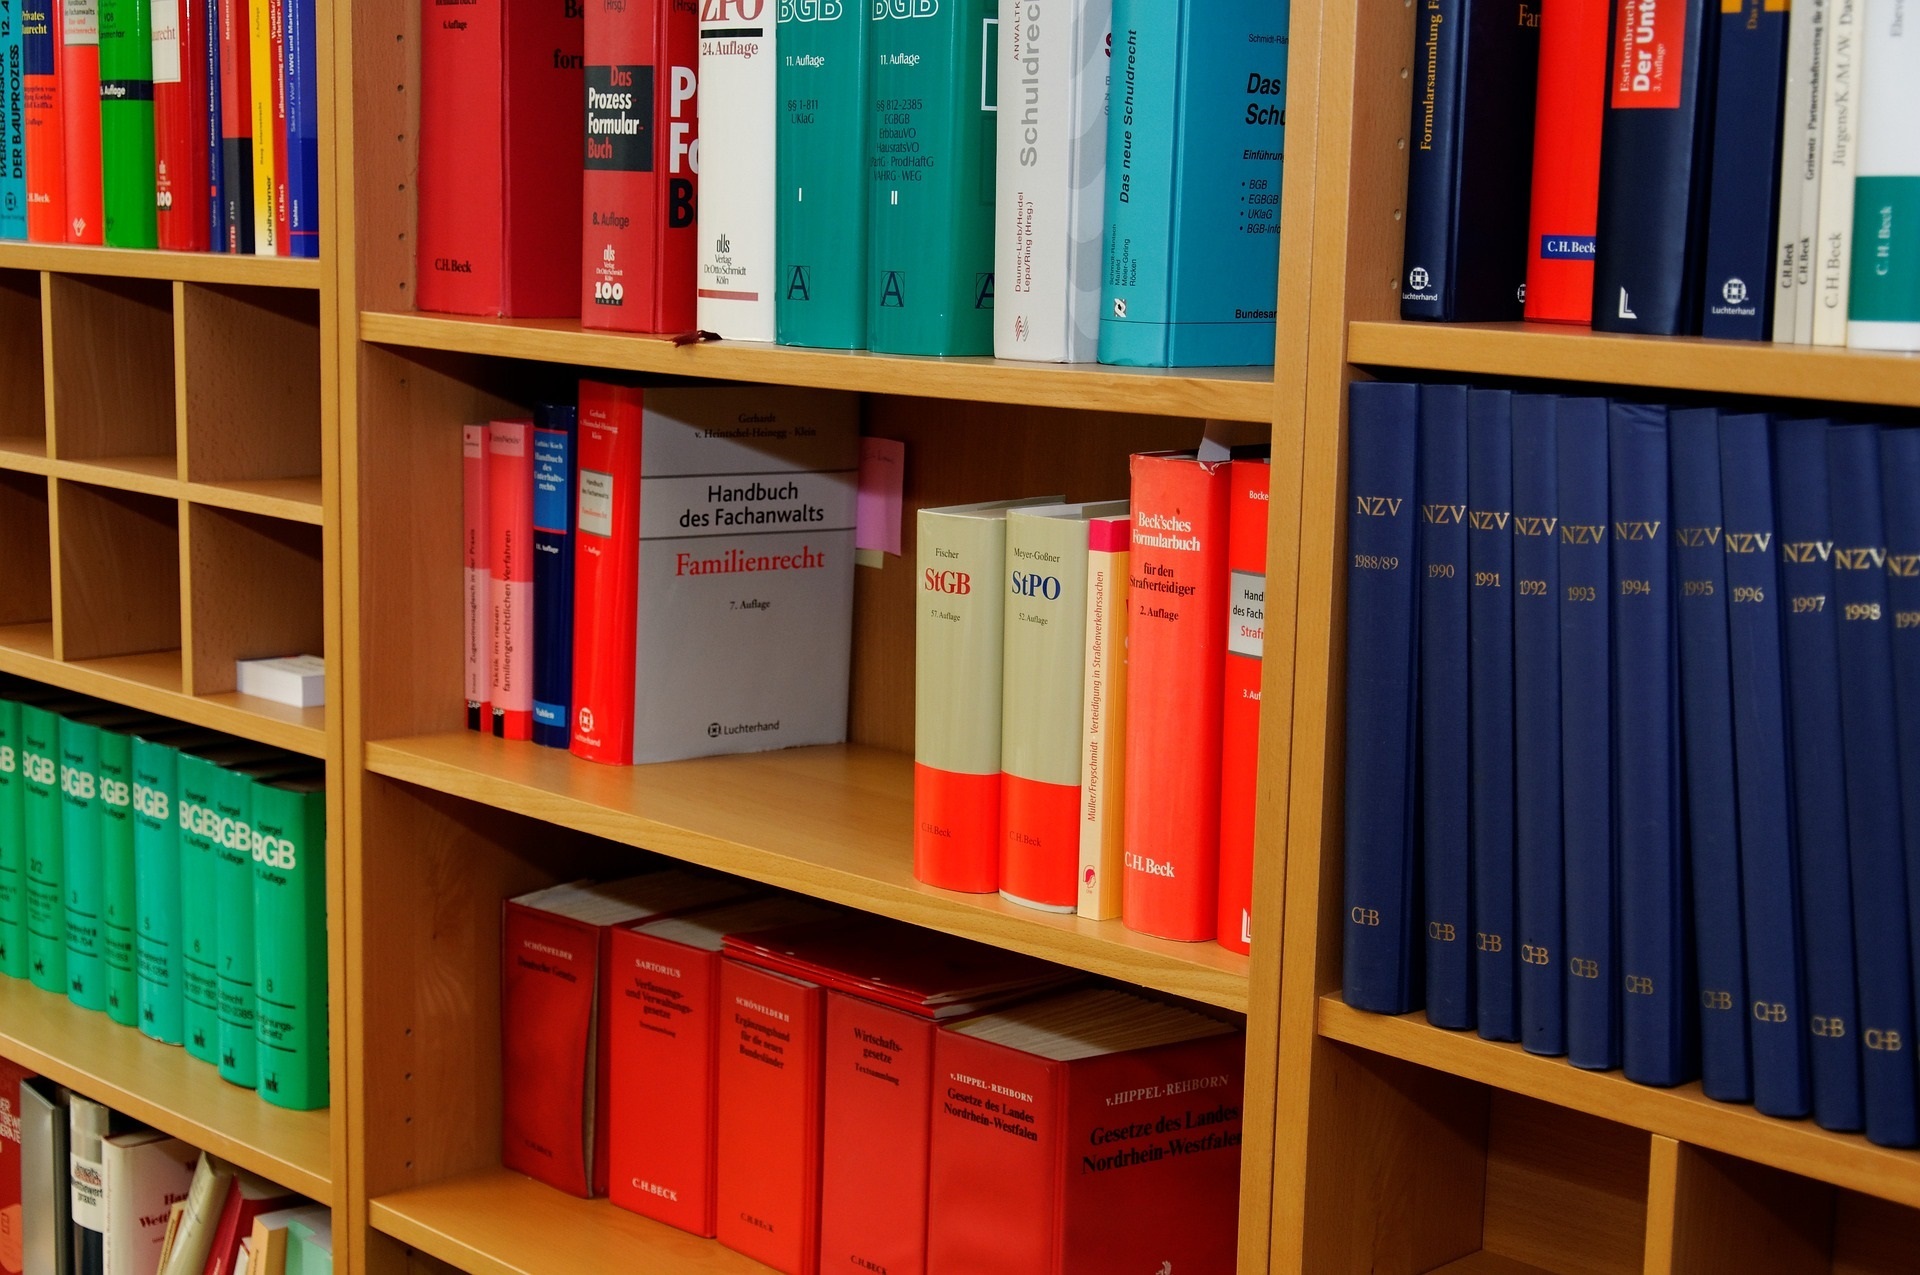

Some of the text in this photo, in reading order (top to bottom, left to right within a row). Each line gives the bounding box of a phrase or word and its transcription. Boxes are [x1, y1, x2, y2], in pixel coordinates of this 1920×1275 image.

[777, 0, 842, 23] BGB
[872, 0, 938, 21] BGB
[2, 20, 10, 37] 12.
[716, 41, 759, 59] Auflage
[1619, 0, 1636, 92] Eschenbruch
[795, 55, 825, 68] Auflage
[889, 53, 920, 67] Auflage
[1653, 43, 1667, 80] Auflage
[610, 66, 632, 87] Das
[1632, 50, 1652, 91] Der
[1246, 72, 1281, 96] Das
[1420, 14, 1443, 151] Formularsammlung
[10, 45, 23, 179] DER BAUPROZESS
[799, 100, 819, 109] 1-811
[886, 99, 923, 110] 812-2385
[884, 113, 910, 124] EGBGB
[1119, 29, 1137, 204] Das neue Schuldrecht
[879, 127, 917, 138] ErbbauVO
[587, 137, 613, 159] Buch
[876, 141, 920, 153] HausratsVO
[1799, 237, 1811, 285] C.H.Beck
[1808, 27, 1823, 130] Partnerschaftsvertrag
[890, 156, 934, 167] ProdHaftG
[901, 170, 922, 181] WEG
[1249, 179, 1268, 190] BGB
[1248, 194, 1279, 205] EGBGB
[602, 212, 630, 229] Auflage
[1247, 208, 1273, 219] UKlaG
[1015, 191, 1024, 292] Dauner-Lieb/Heidel
[1024, 202, 1034, 293] Lepa/Ring (Hrsg.)
[1547, 240, 1596, 254] C.H.Beck
[434, 258, 472, 273] C.H.Beck
[714, 254, 732, 266] Verlag
[1121, 238, 1131, 287] Meier-Göring
[1781, 243, 1794, 289] C.H.Beck
[722, 265, 746, 276] Schmidt
[1825, 232, 1843, 309] C.H.Beck
[716, 276, 729, 285] Köln
[595, 281, 624, 300] 100
[1402, 292, 1438, 302] Luchterhand
[1711, 306, 1756, 316] Luchterhand
[542, 463, 552, 472] des
[708, 481, 798, 503] Handbuch
[1356, 496, 1402, 516] NZV
[1422, 504, 1466, 524] NZV
[679, 504, 824, 528] des Fachanwalts
[1138, 511, 1192, 533] Beck'sches
[1469, 511, 1509, 530] NZV
[1514, 517, 1557, 536] NZV
[1561, 525, 1605, 544] NZV
[1615, 521, 1661, 541] NZV
[1132, 528, 1200, 552] Formularbuch
[1676, 527, 1721, 547] NZV
[1725, 533, 1772, 553] NZV
[675, 546, 825, 577] Familienrecht
[935, 547, 960, 560] Fischer
[1013, 547, 1061, 564] Meyer-Goßner
[1783, 541, 1833, 563] NZV
[1834, 547, 1887, 570] NZV
[1143, 562, 1174, 578] für den
[1354, 554, 1399, 570] 1988/89
[1428, 564, 1454, 578] 1990
[925, 567, 971, 595] StGB
[1011, 570, 1061, 601] StPO
[1129, 575, 1196, 598] Strafverteidiger
[1474, 572, 1501, 587] 1991
[1519, 580, 1547, 595] 1992
[1621, 580, 1650, 595] 1994
[1683, 581, 1714, 596] 1995
[1567, 587, 1596, 602] 1993
[1733, 587, 1764, 602] 1996
[1792, 596, 1826, 612] 1997
[503, 530, 512, 692] familiengerichtlichen Verfahren
[729, 599, 771, 612] 7. Auflage
[1139, 606, 1179, 622] 2. Auflage
[1232, 606, 1264, 620] des Fach
[1845, 603, 1881, 622] 1998
[1087, 571, 1104, 822] Müller/Freyschmidt Verteidigung in Straßenverkehrssachen
[724, 721, 780, 736] Luchterhand
[61, 764, 95, 799] BGB
[132, 782, 169, 820] BGB
[921, 822, 952, 838] C.H.Beck
[1009, 830, 1042, 847] C.H.Beck
[251, 831, 296, 870] BGB
[1124, 851, 1175, 878] C.H.Beck
[635, 958, 681, 979] SARTORIUS
[853, 1026, 903, 1052] Wirtschafts-
[862, 1048, 892, 1064] gesetze
[947, 1087, 1035, 1124] Gesetze des Landes
[943, 1102, 1038, 1142] Nordrhein-Westfalen
[1089, 1104, 1239, 1146] Gesetze des Landes
[632, 1177, 678, 1202] C.H.BECK
